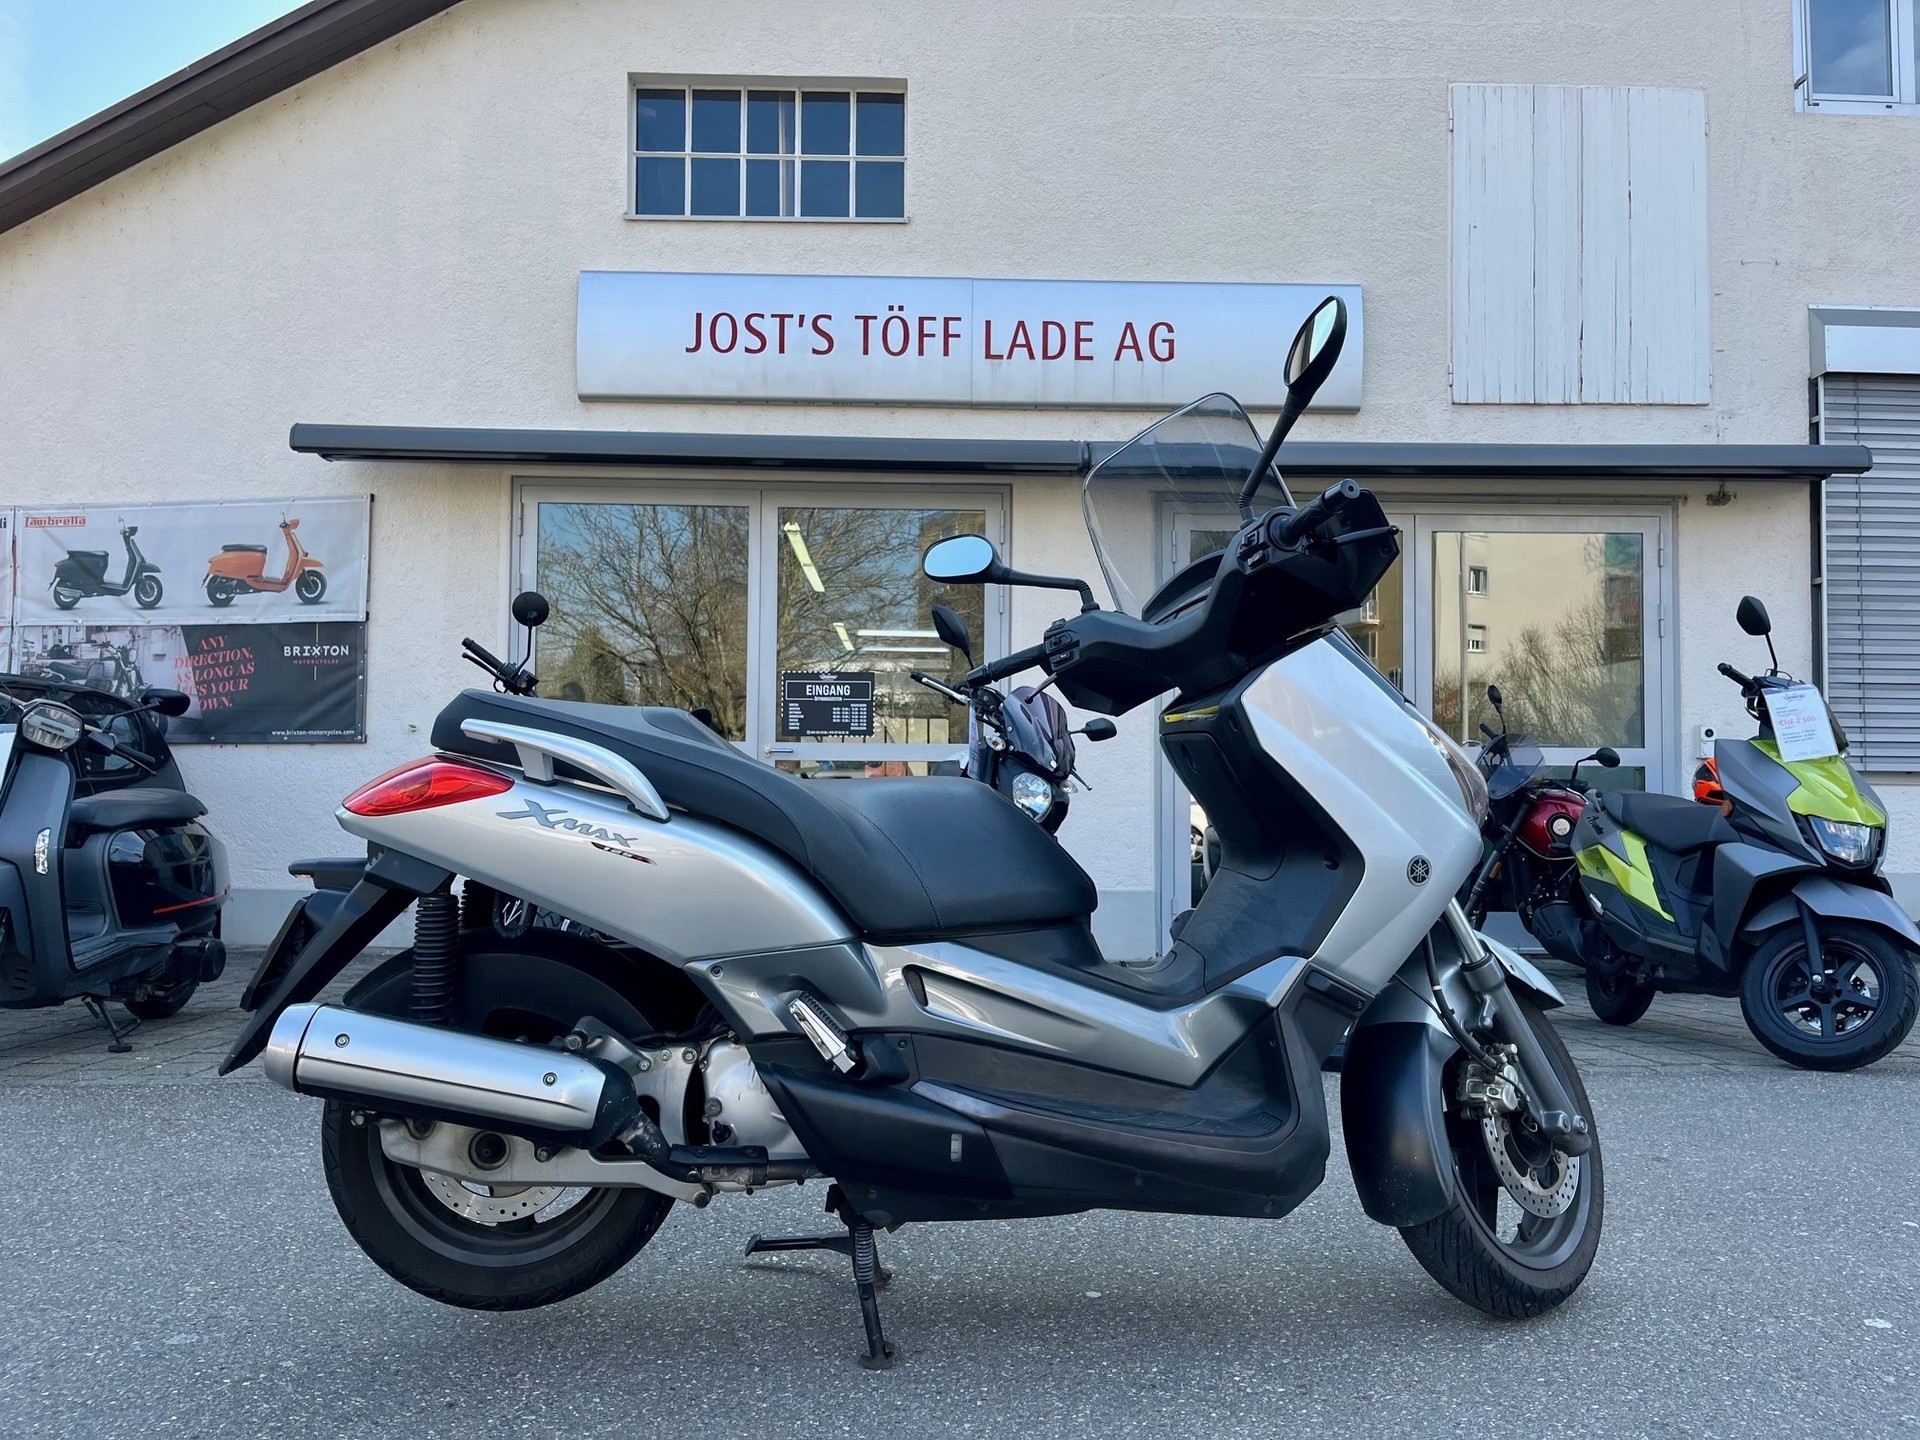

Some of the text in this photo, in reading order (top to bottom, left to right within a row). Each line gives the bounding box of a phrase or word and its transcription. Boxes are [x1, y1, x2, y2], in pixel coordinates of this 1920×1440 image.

[685, 305, 1175, 362] JOST'S TÖFF LADE AG
[199, 635, 227, 650] ANY
[175, 647, 253, 669] DIRECTION.
[283, 645, 349, 657] BRIXTON
[195, 665, 233, 681] LONG
[237, 662, 255, 676] AS
[211, 678, 249, 694] YOUR
[806, 684, 851, 696] EINGANG
[198, 696, 233, 711] OWN.
